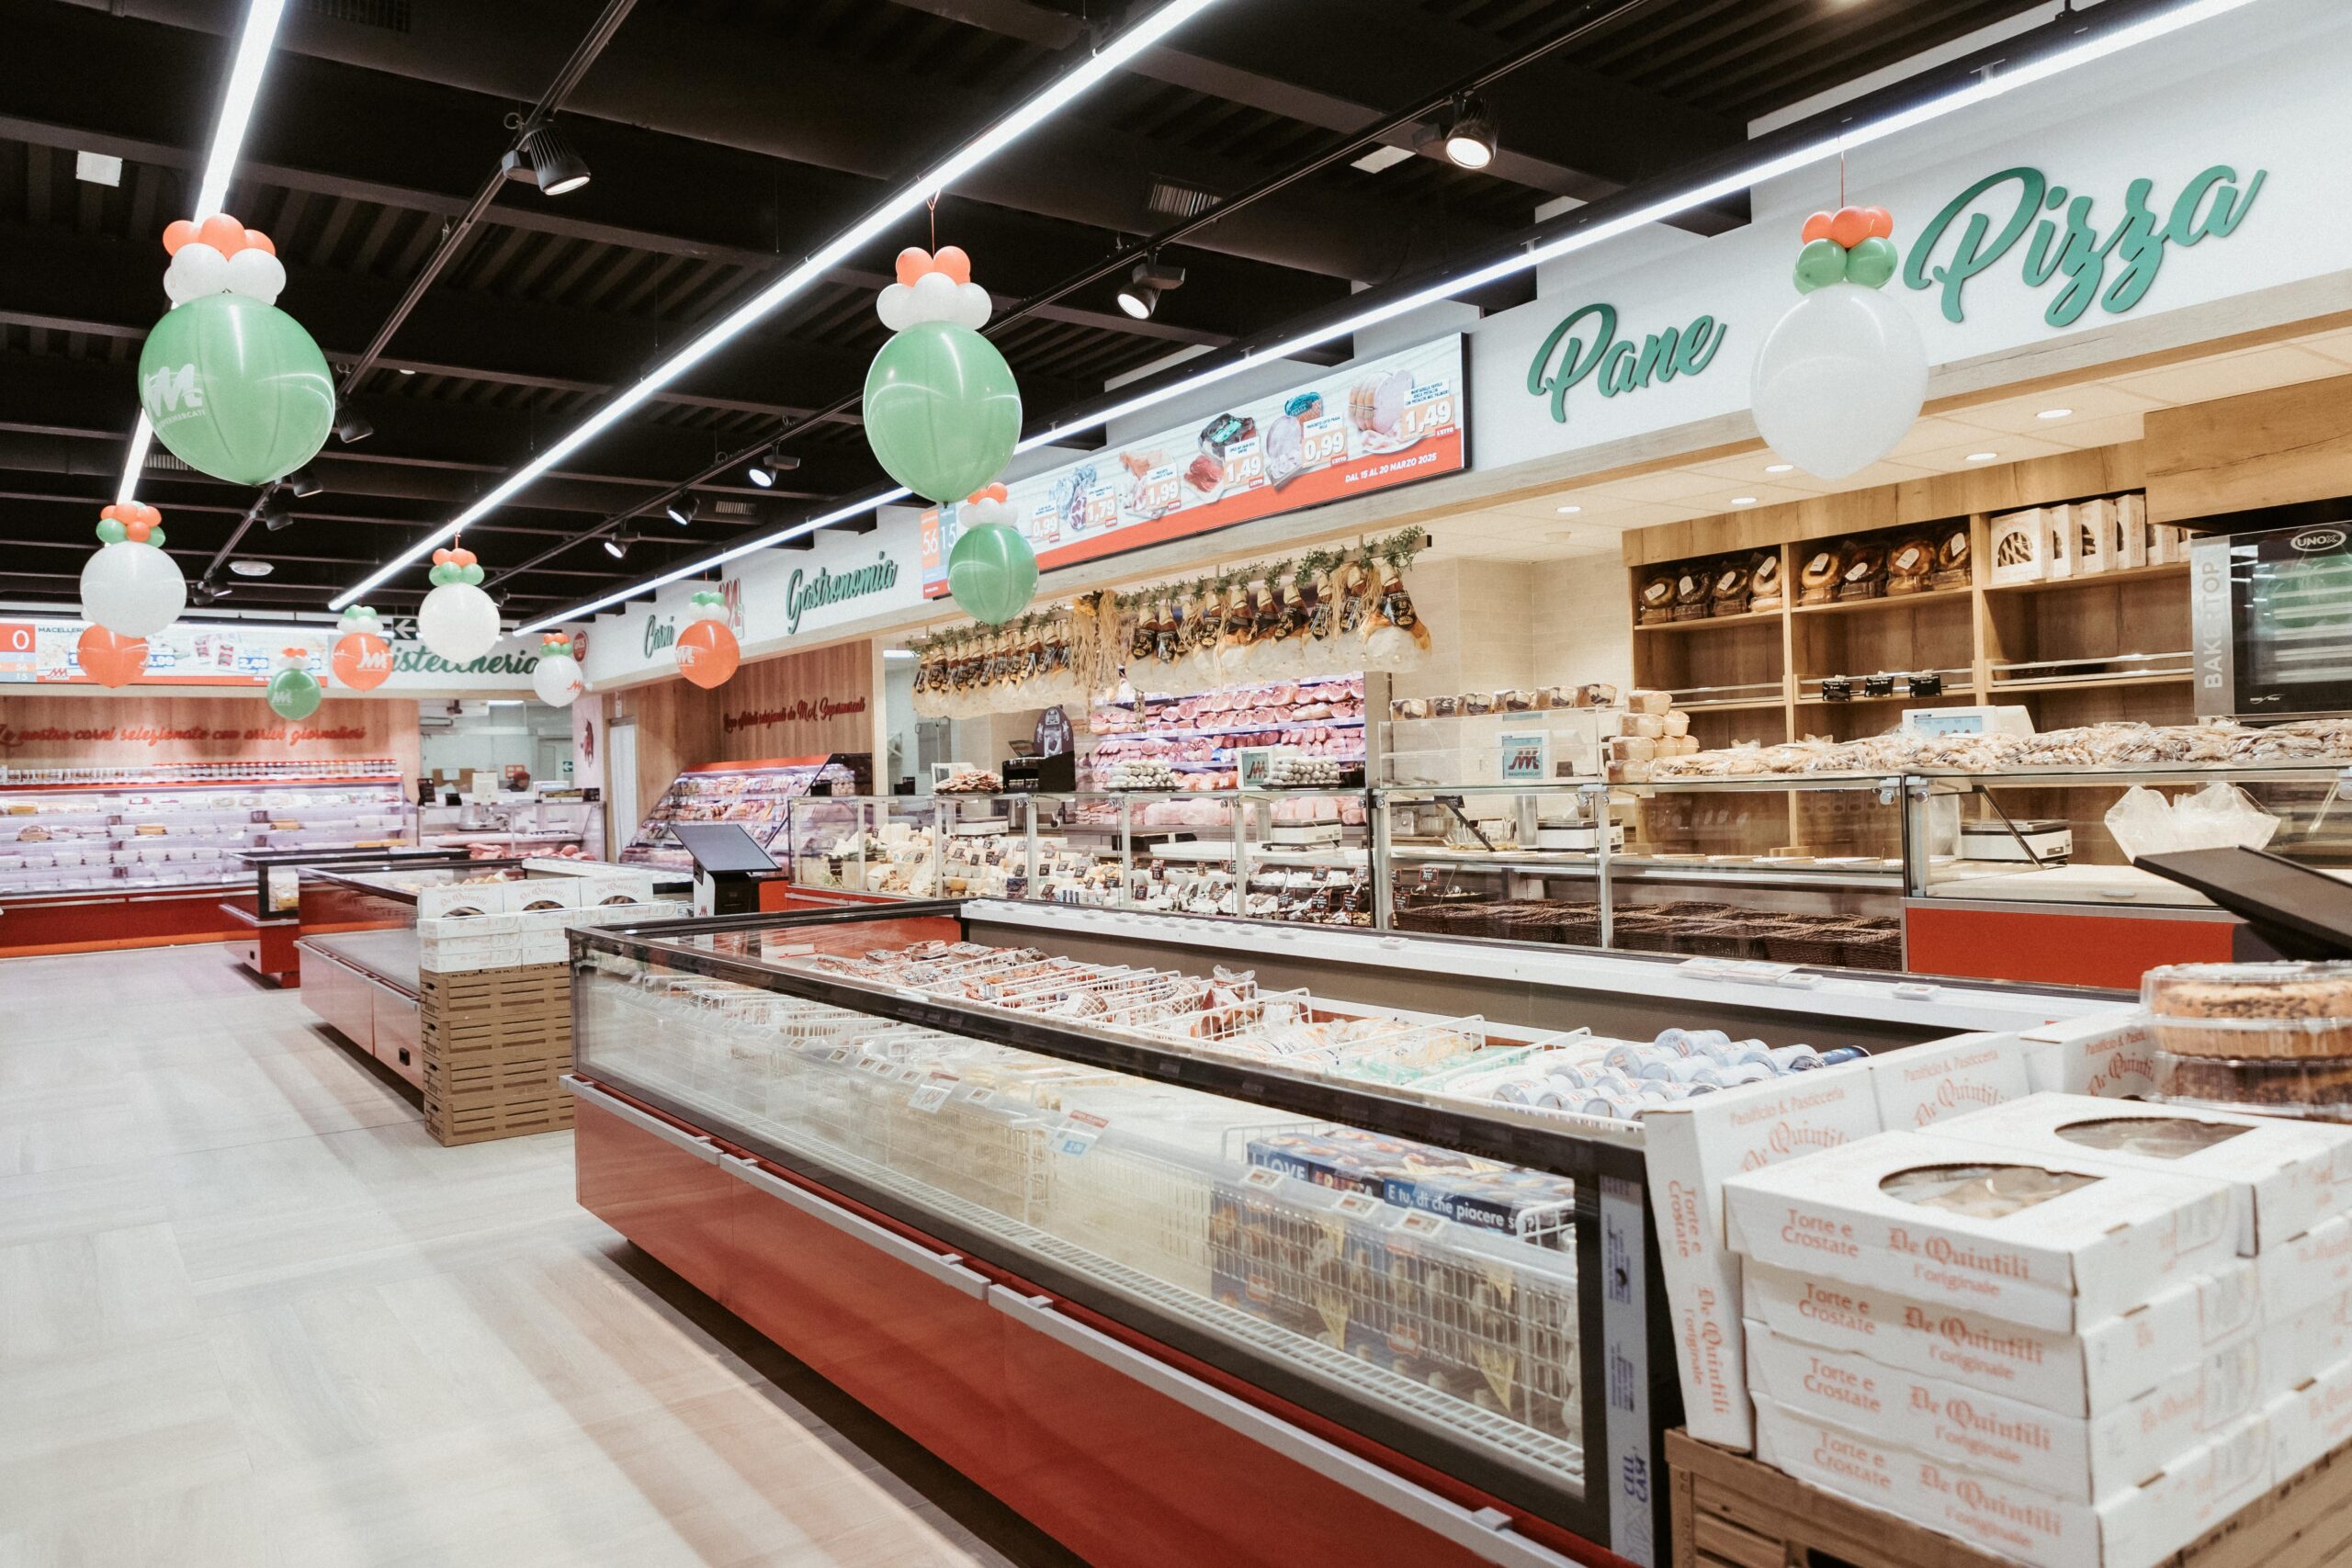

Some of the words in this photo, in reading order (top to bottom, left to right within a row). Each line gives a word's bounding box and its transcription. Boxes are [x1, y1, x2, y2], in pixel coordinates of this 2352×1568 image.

[1903, 164, 2267, 327] Pizza
[1527, 302, 1726, 423] Pane
[1405, 400, 1453, 434] 1,49
[1305, 432, 1345, 461] 0,99
[1225, 456, 1262, 483] 1,49
[1345, 474, 1359, 483] DAL
[1360, 470, 1368, 479] 15
[1369, 468, 1378, 477] AL
[1379, 464, 1389, 474] 20
[1390, 457, 1417, 470] MARZO
[1418, 453, 1437, 465] 2025
[1148, 481, 1179, 505] 1,99
[1087, 500, 1115, 522] 1,79
[922, 529, 938, 556] 56
[2297, 534, 2339, 548] UNOX
[786, 551, 898, 634] Gastronomia
[1769, 1121, 1849, 1154] Quintil
[1388, 1184, 1396, 1200] E
[1431, 1196, 1453, 1213] che
[1456, 1201, 1505, 1227] piacere
[1668, 1179, 1689, 1258] Crostate
[1684, 1188, 1699, 1236] Torte
[1692, 1241, 1702, 1253] e
[1787, 1209, 1835, 1235] Torte
[1841, 1224, 1853, 1237] e
[1781, 1225, 1860, 1258] Crostate
[1888, 1227, 1918, 1255] De
[1925, 1236, 2030, 1280] Quintili
[1699, 1288, 1716, 1315] De
[1805, 1282, 1852, 1309] Torte
[1858, 1301, 1869, 1314] e
[1798, 1300, 1876, 1334] Crostate
[1904, 1305, 1934, 1333] De
[1940, 1316, 2043, 1366] Quintili
[1702, 1321, 1730, 1415] Quintili
[1810, 1356, 1858, 1385] Torte
[1862, 1377, 1874, 1391] e
[1804, 1374, 1881, 1412] Crostate
[1909, 1385, 1939, 1415] De
[1946, 1398, 2052, 1451] Quintili
[1818, 1431, 1868, 1461] Torte
[1872, 1453, 1885, 1468] e
[1813, 1447, 1892, 1490] Crostate
[1919, 1464, 1951, 1494] De
[1955, 1479, 2063, 1538] Quintili
